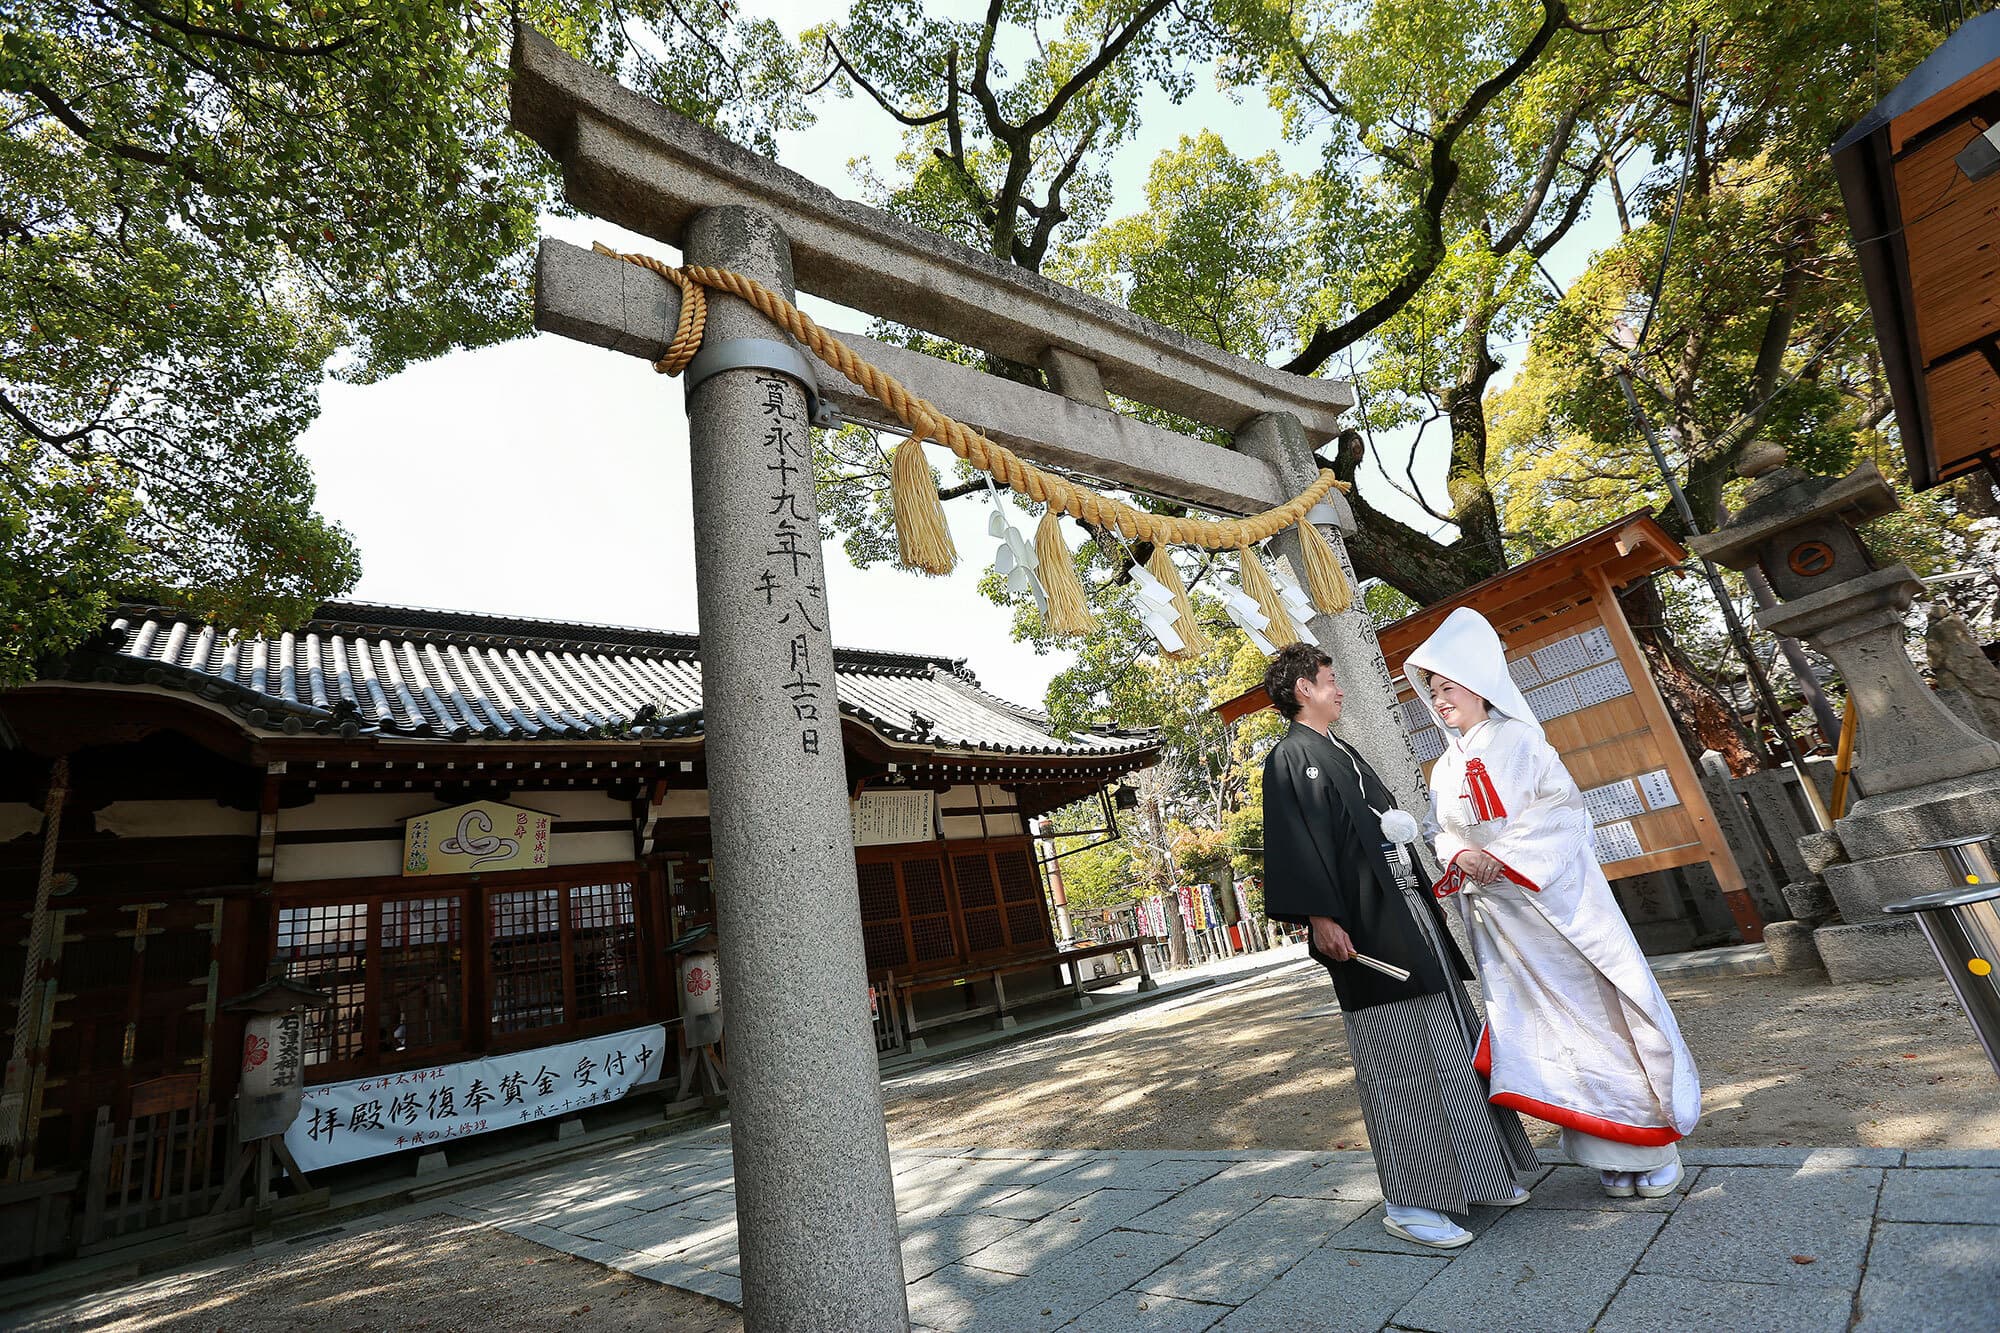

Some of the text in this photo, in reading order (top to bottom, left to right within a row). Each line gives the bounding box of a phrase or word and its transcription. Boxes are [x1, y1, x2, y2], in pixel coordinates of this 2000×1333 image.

[410, 821, 422, 869] 石津太神社
[271, 1013, 299, 1088] 石津太神社
[358, 1067, 446, 1092] 石津太神社
[394, 1119, 489, 1149] 平成の大修理
